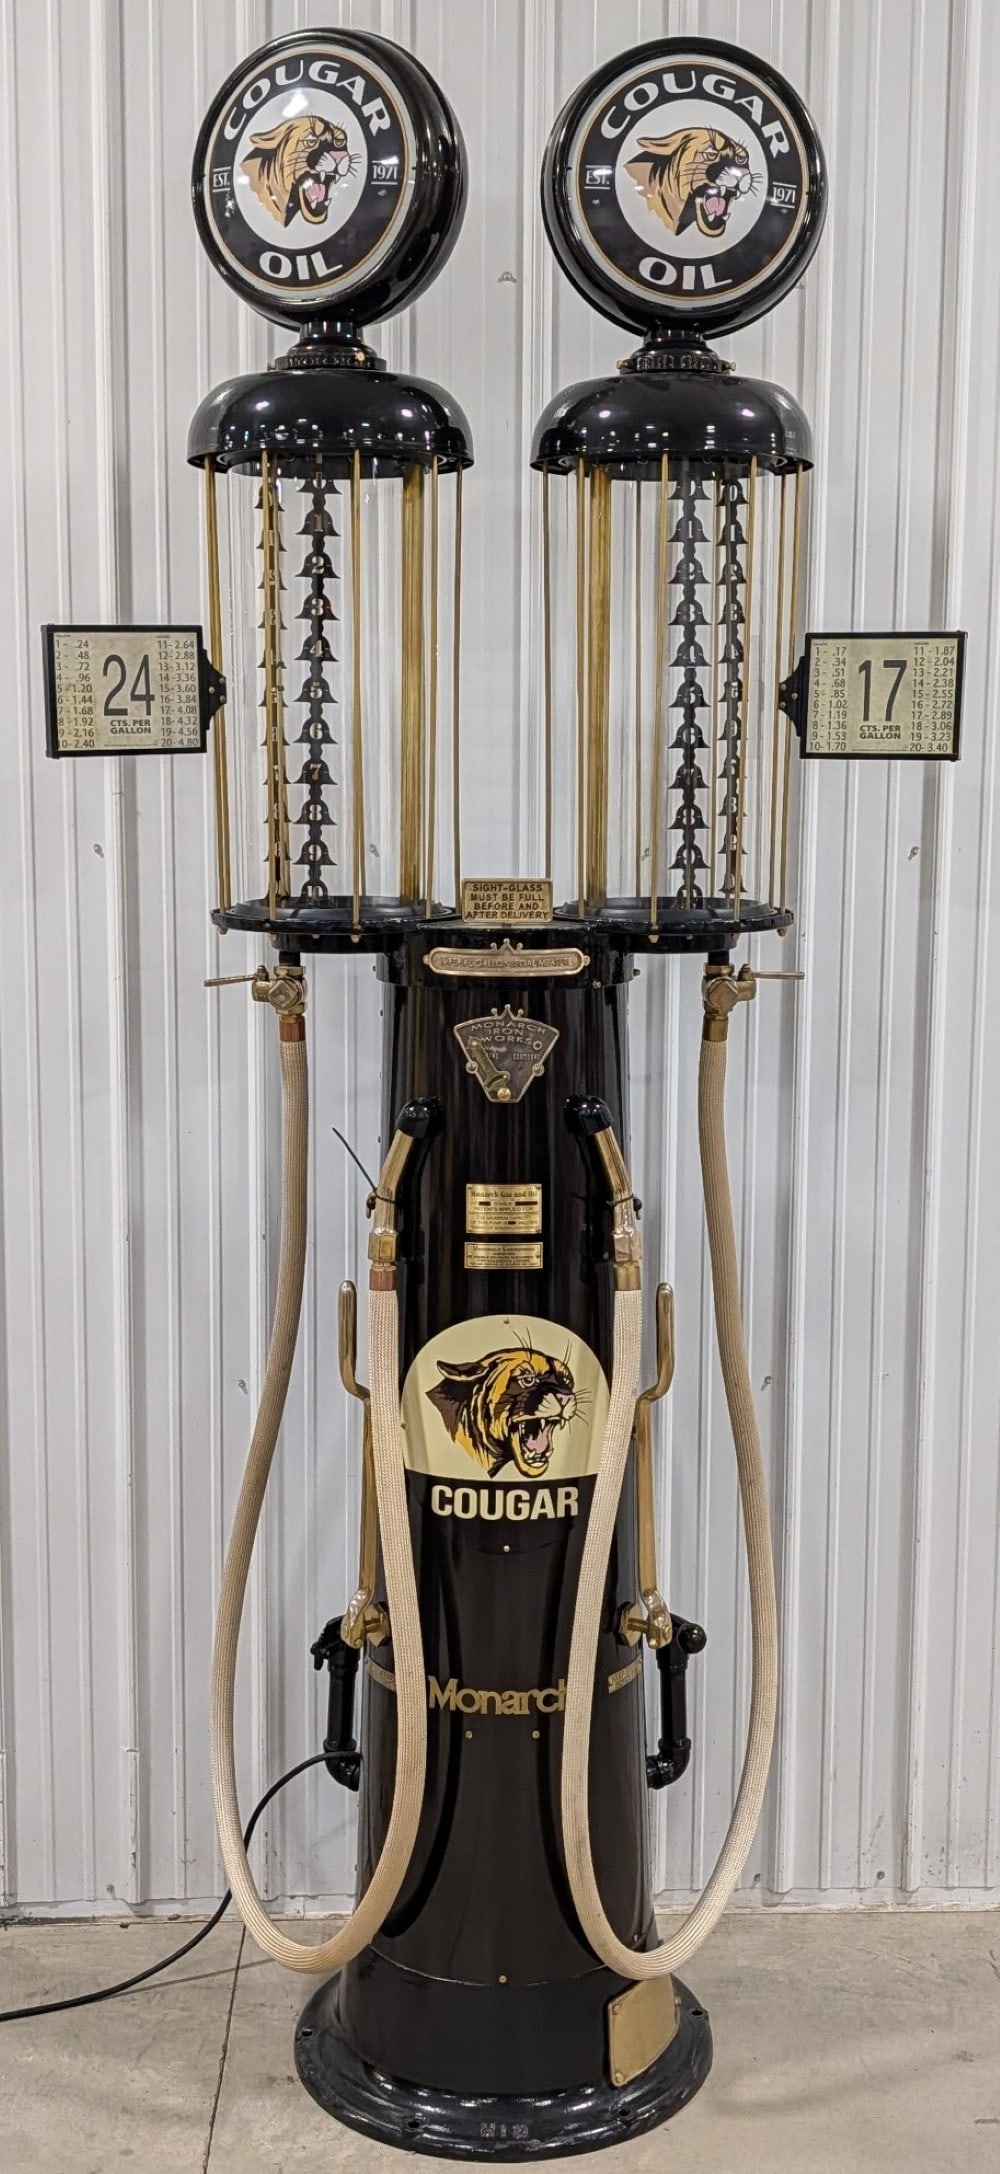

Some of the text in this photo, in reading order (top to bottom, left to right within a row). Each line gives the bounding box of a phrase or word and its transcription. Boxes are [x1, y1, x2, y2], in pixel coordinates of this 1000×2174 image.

[224, 59, 391, 140] COUGAR
[601, 70, 790, 158] COUGAR
[213, 173, 231, 188] EST.
[372, 165, 397, 180] 1971
[585, 168, 610, 185] EST.
[773, 186, 795, 204] 1971
[259, 250, 343, 280] OIL
[639, 257, 732, 290] OIL
[311, 556, 324, 574] 2
[311, 598, 324, 616] 3
[310, 640, 323, 657] 4
[102, 654, 155, 716] 24
[309, 682, 323, 699] 5
[858, 660, 907, 722] 17
[110, 719, 151, 727] CTS. PER
[309, 723, 323, 740] 6
[859, 732, 901, 740] GALLON
[310, 763, 322, 780] 7
[309, 804, 322, 821] 8
[309, 844, 322, 861] 9
[473, 884, 543, 892] SIGHT-GLASS
[474, 901, 539, 910] BEFORE AND
[466, 911, 549, 919] AFTER DELIVERY
[471, 1020, 546, 1035] MONARCH
[488, 1027, 524, 1036] IRON
[481, 1035, 532, 1045] WORKS
[431, 1485, 579, 1521] COUGAR
